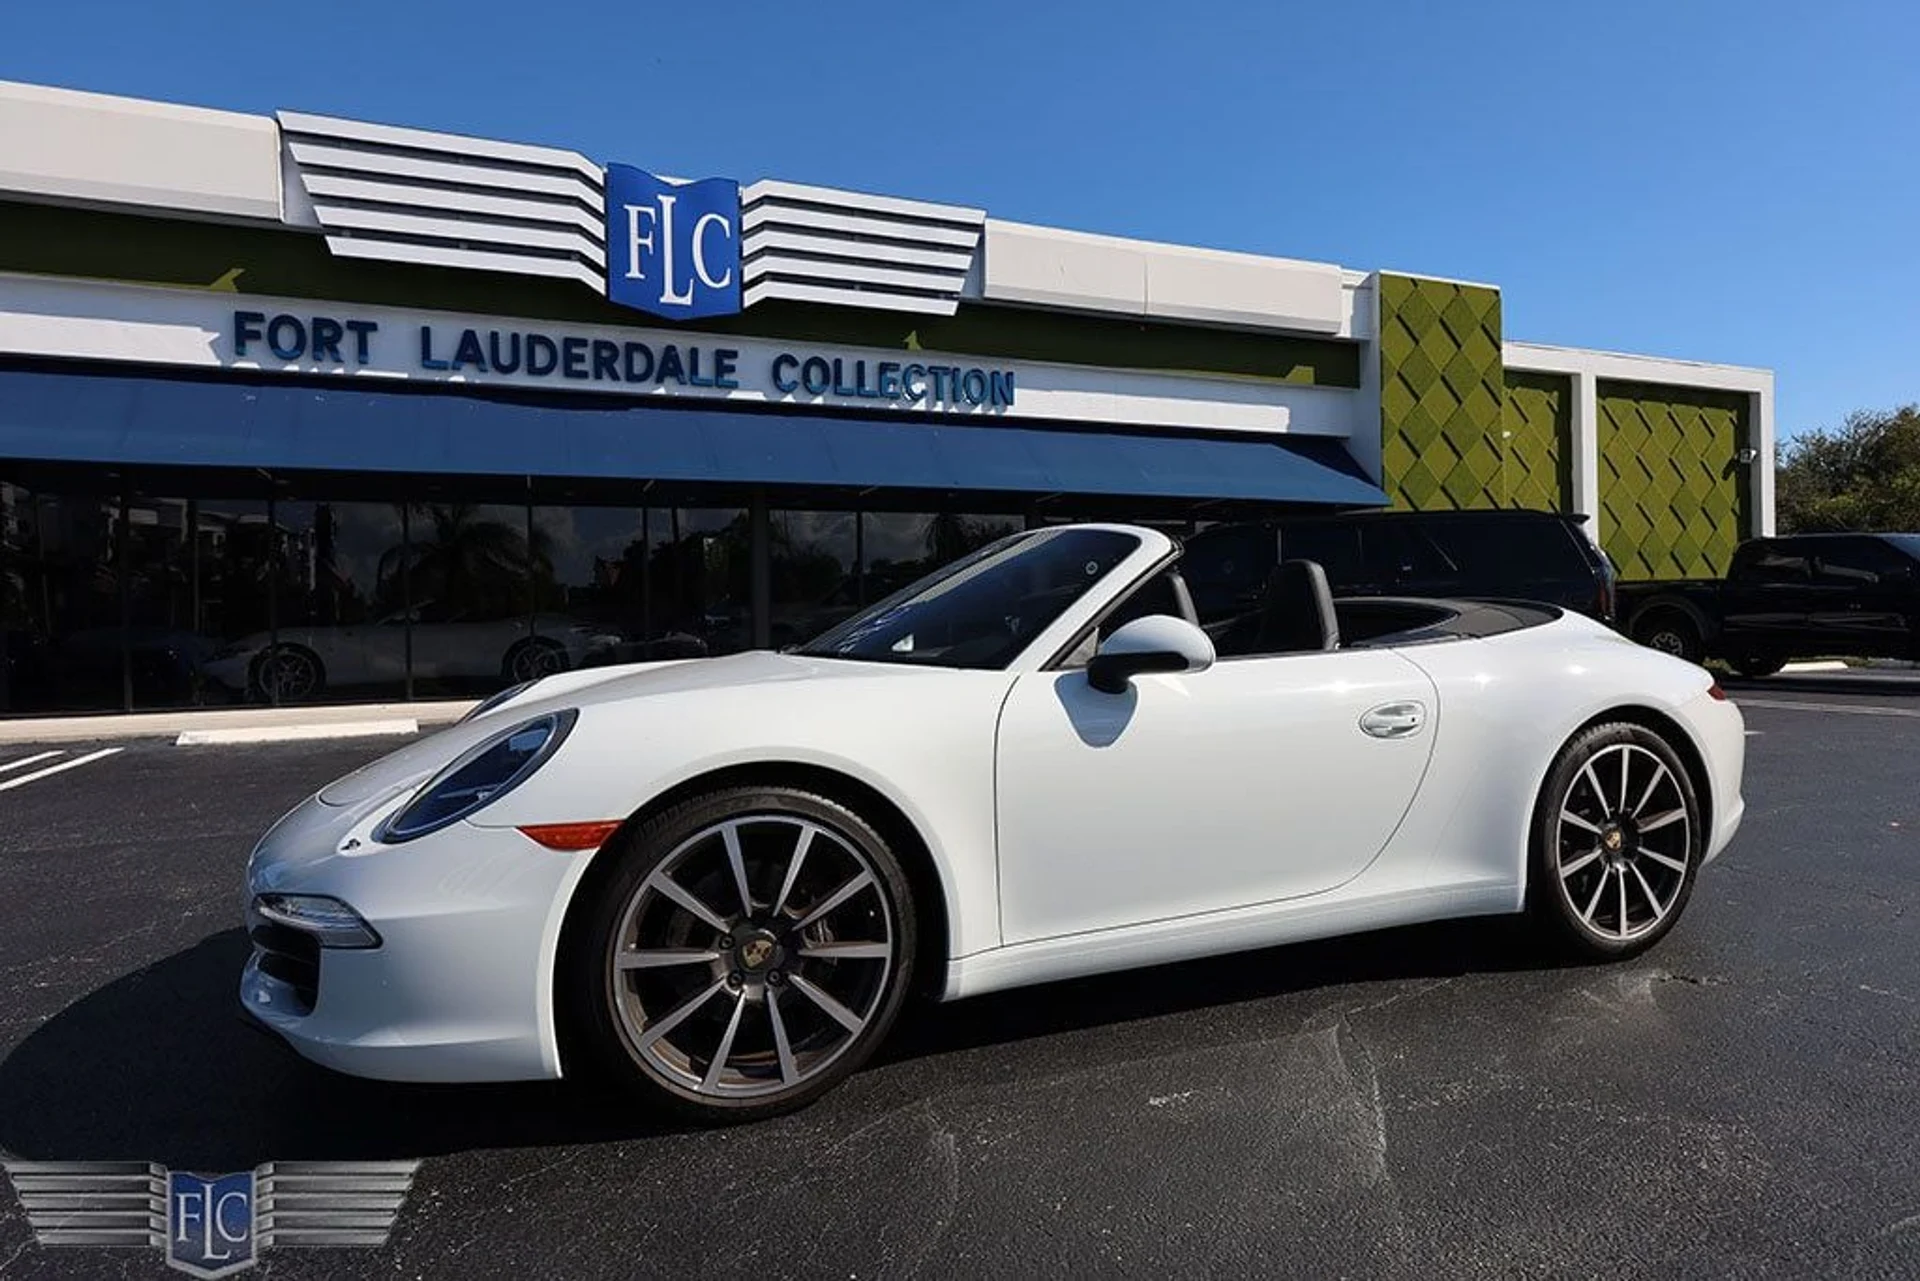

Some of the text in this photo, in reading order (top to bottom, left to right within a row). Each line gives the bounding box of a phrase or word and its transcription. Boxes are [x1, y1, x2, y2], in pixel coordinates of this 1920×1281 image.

[623, 194, 731, 305] FLC
[232, 310, 1015, 407] FORT LAUDERDALE COLLECTION
